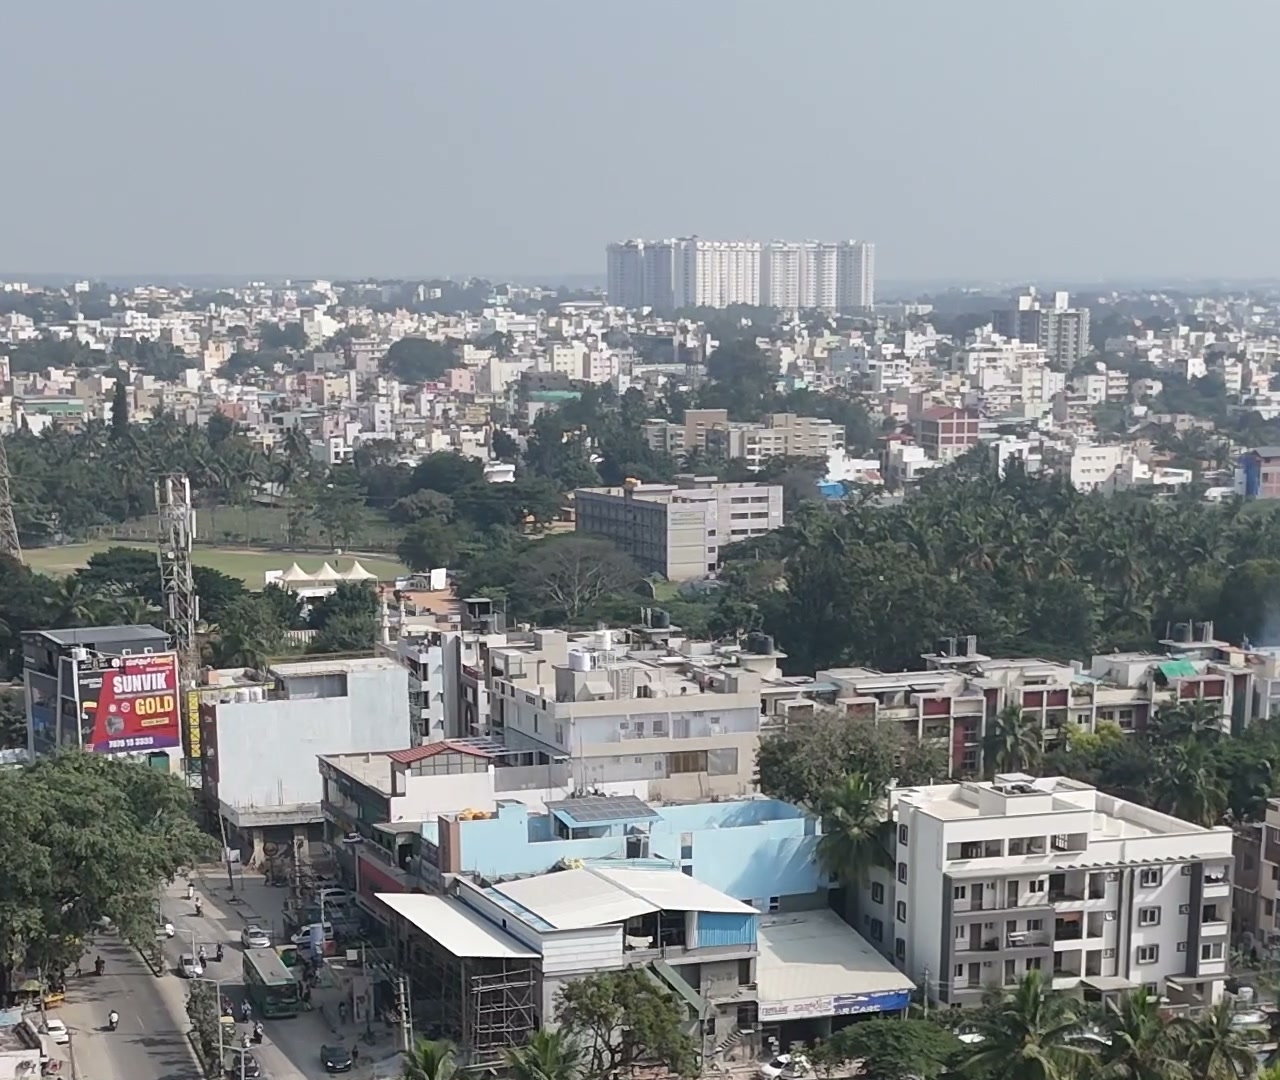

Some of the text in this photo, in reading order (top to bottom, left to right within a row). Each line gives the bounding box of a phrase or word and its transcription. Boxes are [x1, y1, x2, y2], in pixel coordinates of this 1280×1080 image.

[113, 673, 166, 694] SUNVIK
[135, 696, 174, 715] GOLD
[851, 1005, 881, 1014] CARE
